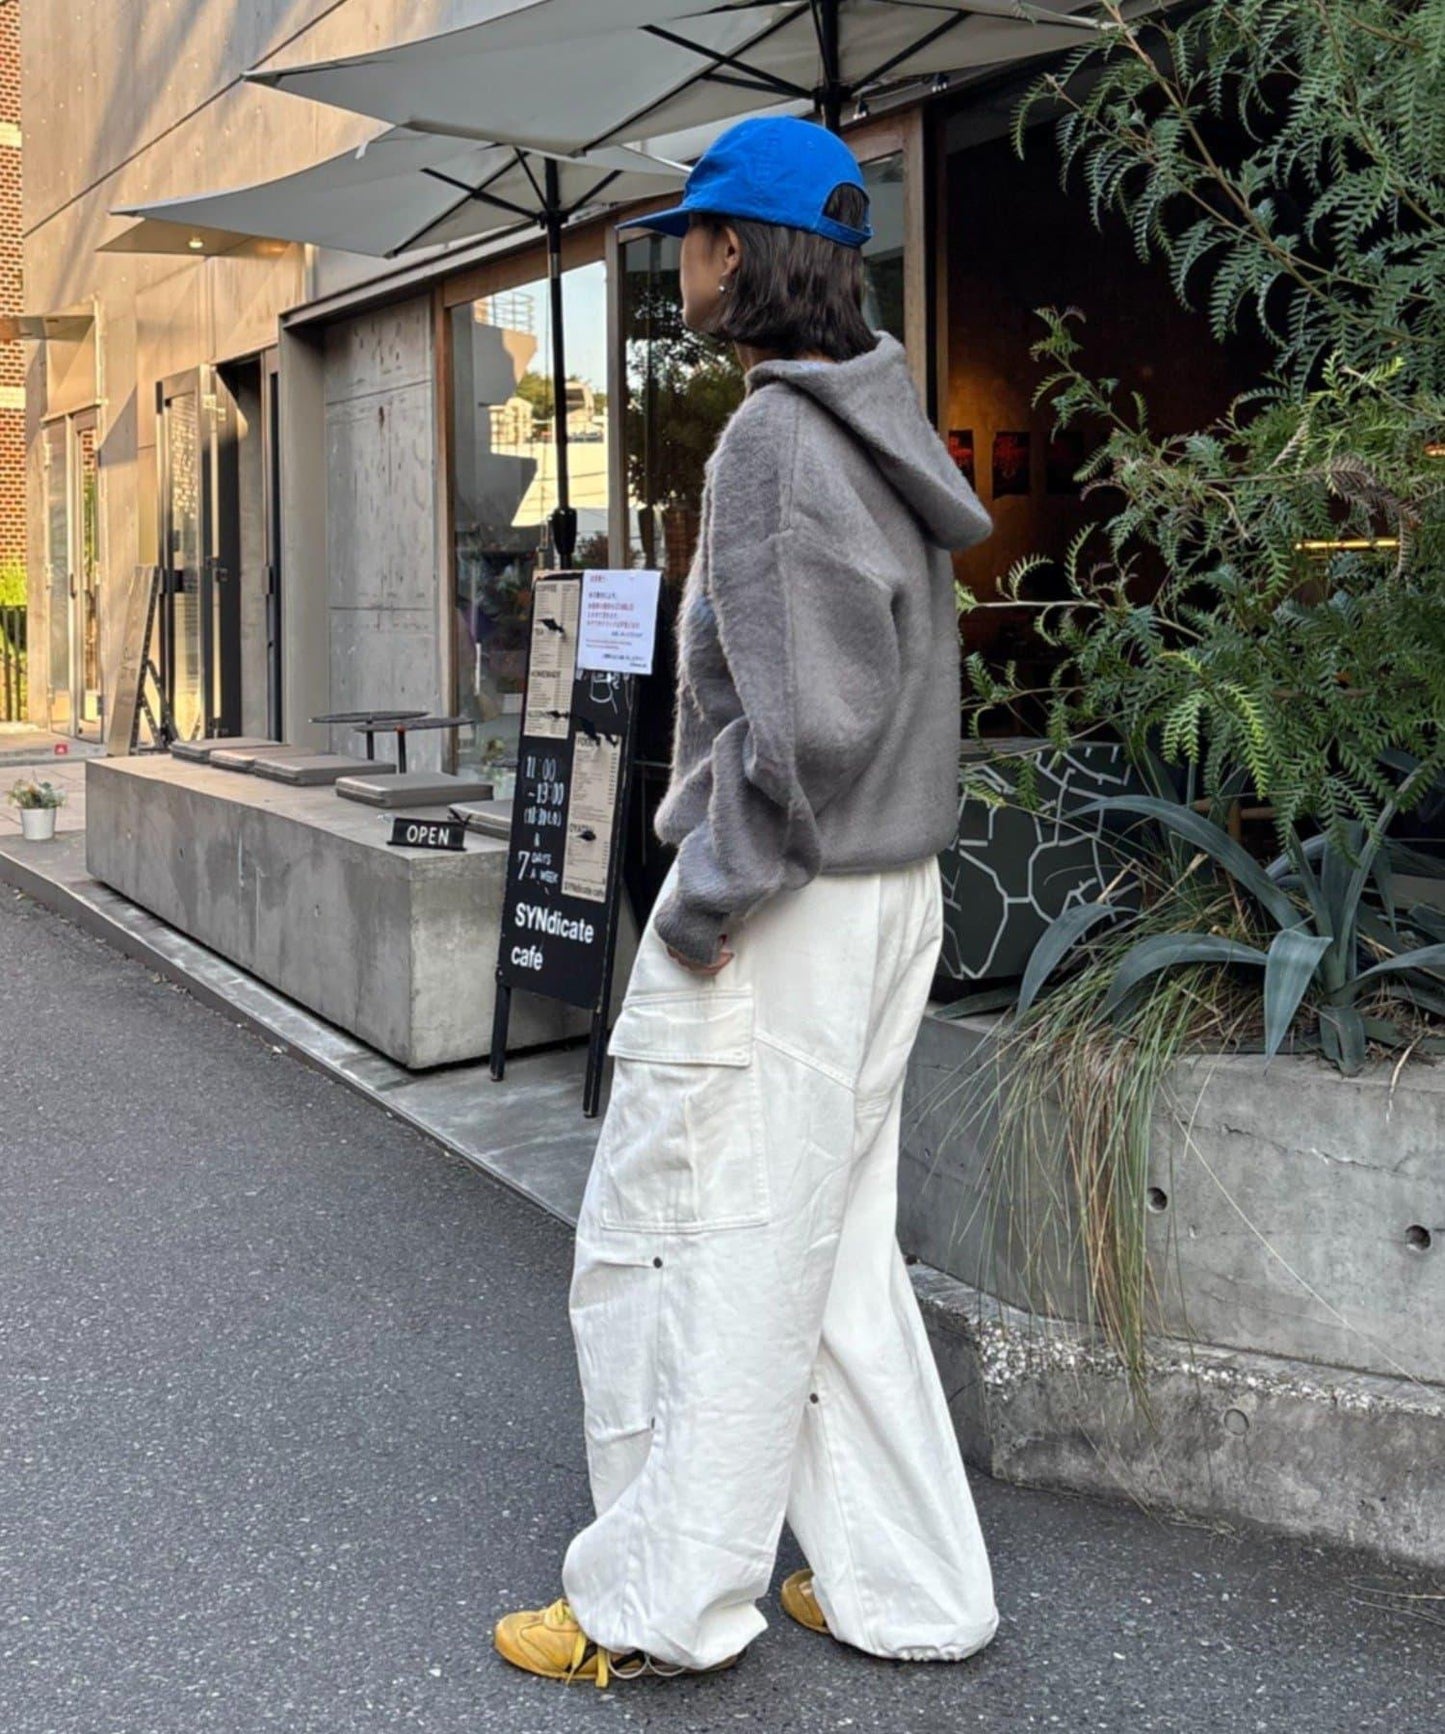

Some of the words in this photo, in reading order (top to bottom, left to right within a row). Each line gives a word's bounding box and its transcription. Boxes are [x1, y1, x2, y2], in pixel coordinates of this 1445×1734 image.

[406, 824, 450, 846] OPEN
[518, 850, 531, 880] 7
[514, 901, 595, 944] SYNdicate
